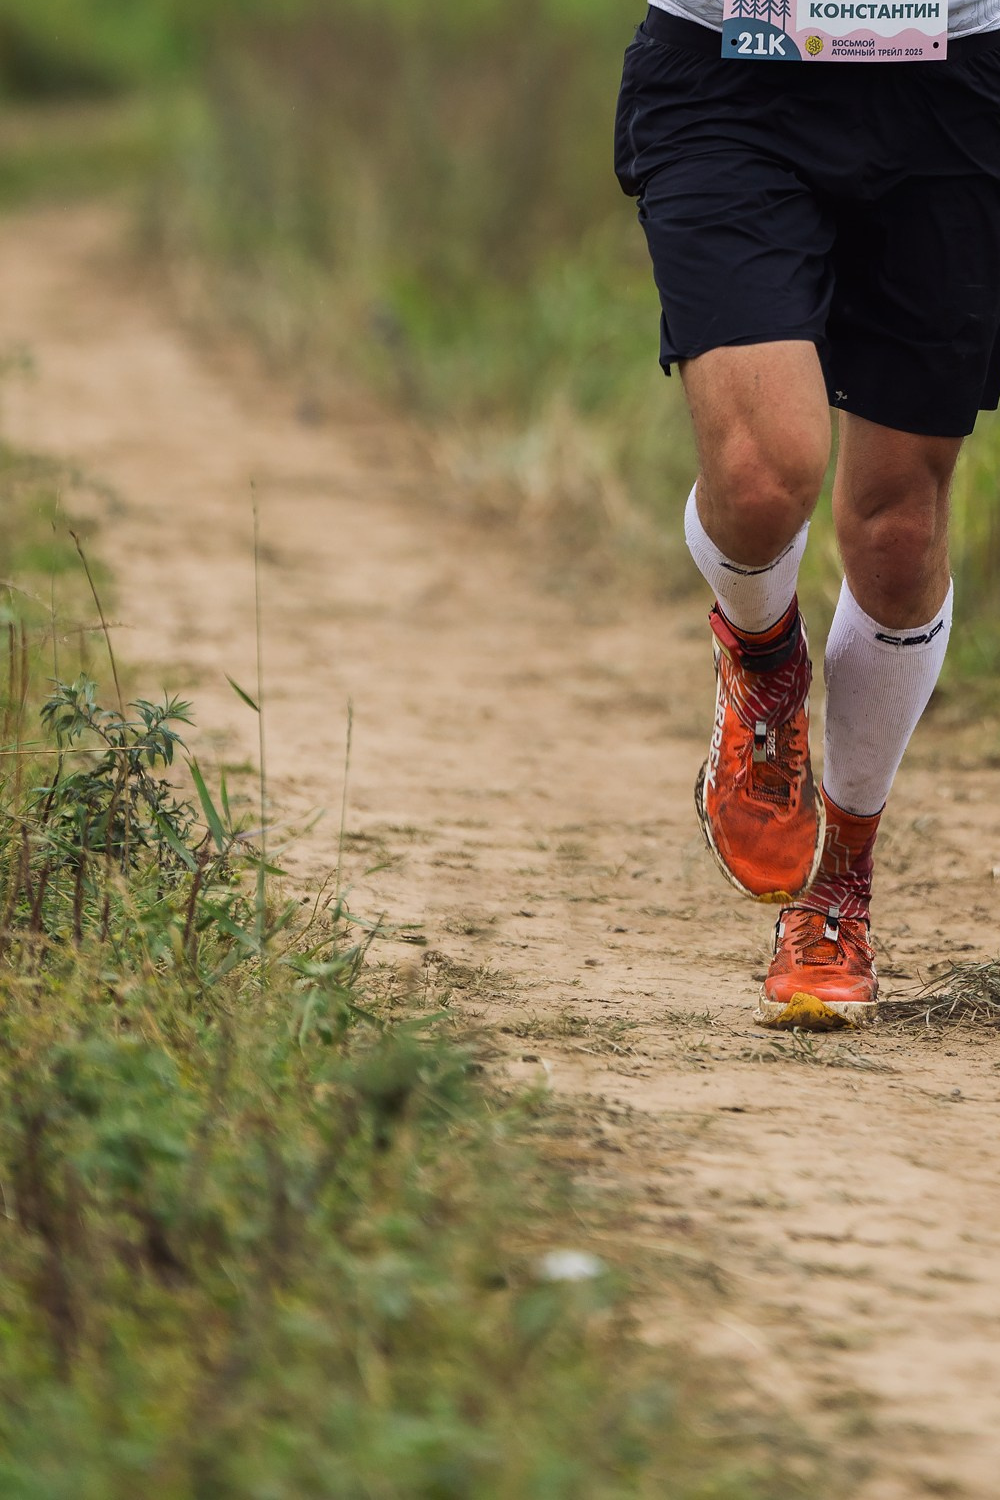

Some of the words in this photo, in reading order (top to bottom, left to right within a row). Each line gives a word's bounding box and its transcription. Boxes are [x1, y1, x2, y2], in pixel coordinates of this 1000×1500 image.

[809, 2, 940, 19] КОНСТАНТИН
[738, 32, 786, 56] 21K
[831, 38, 876, 48] ВОСЬМОЙ
[831, 46, 876, 56] АТОМНЫЙ
[878, 46, 903, 56] ТРЕЙЛ
[904, 47, 924, 56] 2025
